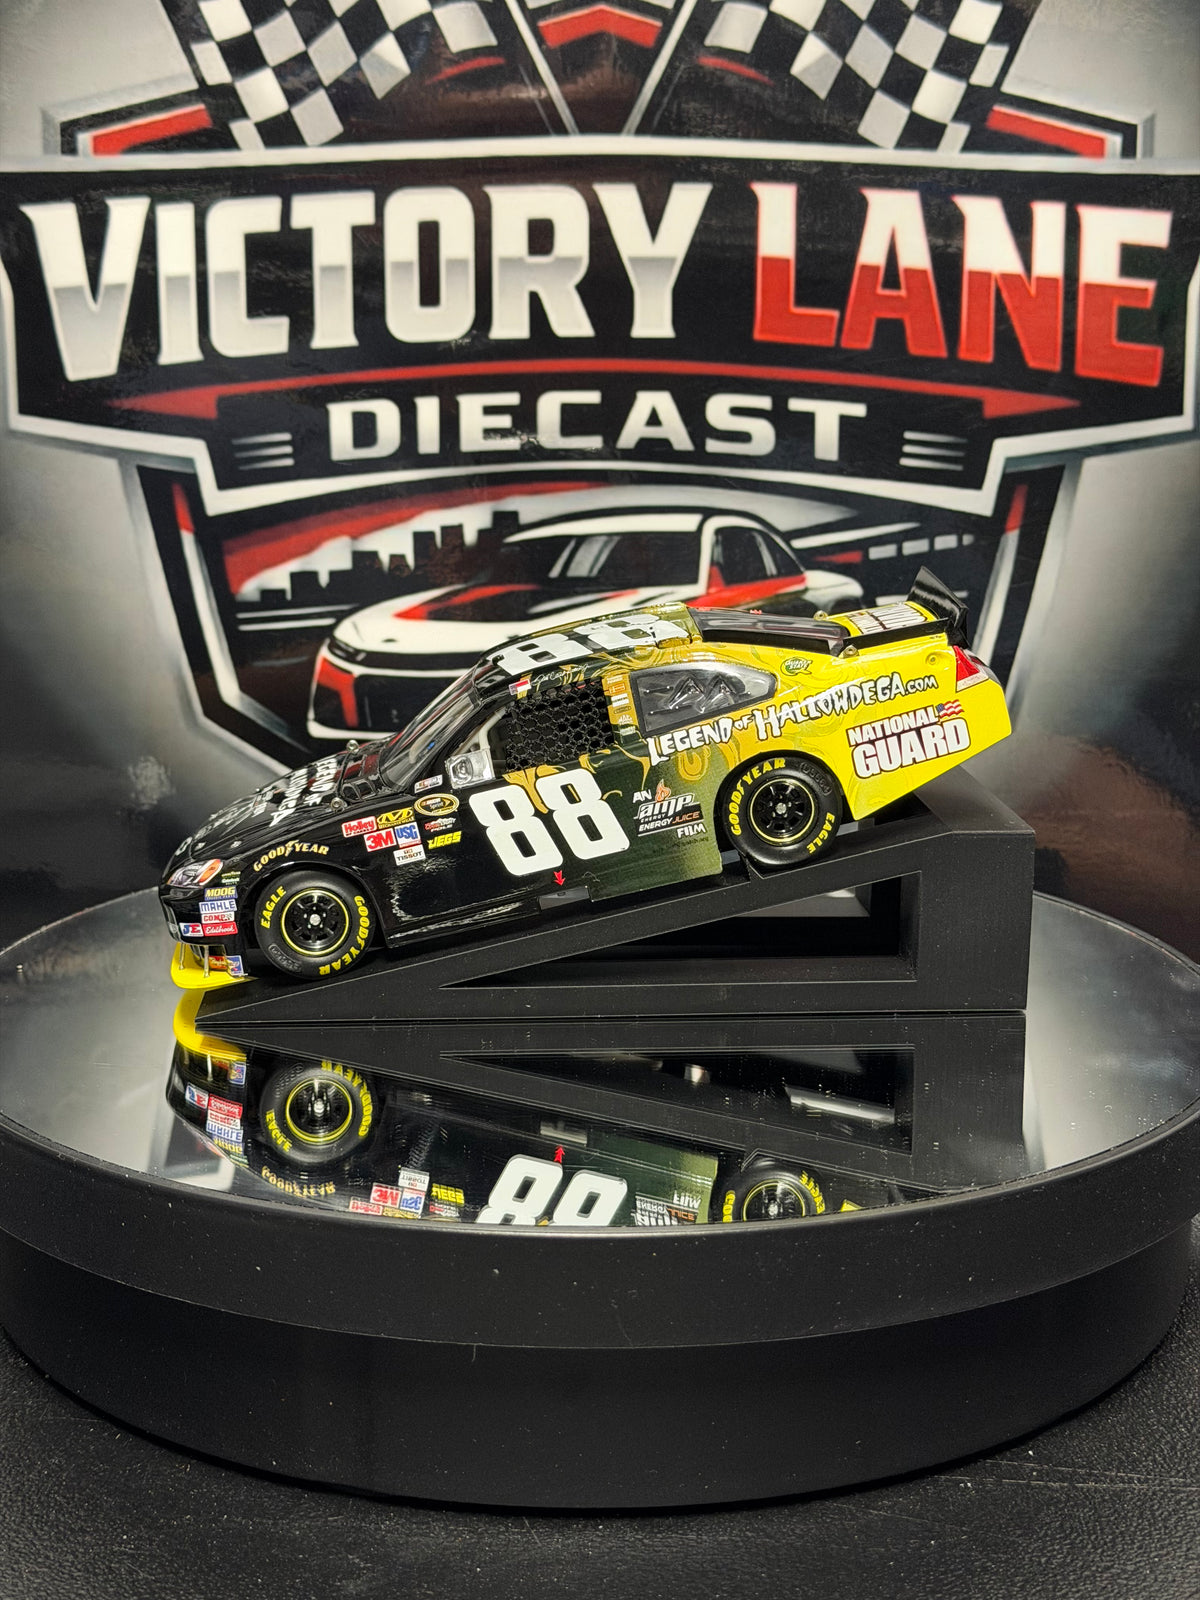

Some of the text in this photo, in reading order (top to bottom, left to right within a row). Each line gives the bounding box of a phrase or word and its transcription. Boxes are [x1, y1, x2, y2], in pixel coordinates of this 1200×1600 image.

[19, 182, 1172, 387] VICTORY LANE
[327, 390, 867, 461] DIECAST
[846, 704, 940, 748] NATIONAL
[645, 717, 735, 767] LEGEND
[734, 715, 752, 731] OF
[852, 718, 971, 779] GUARD
[633, 789, 652, 803] AN
[729, 757, 786, 836] GOODYEAR
[344, 820, 375, 834] Holley
[469, 768, 630, 876] 88
[639, 811, 700, 832] ENERGY JUICE
[640, 813, 666, 823] ENERGY
[366, 830, 394, 849] 3M
[396, 825, 419, 840] USG
[428, 831, 462, 850] JEGS
[677, 823, 706, 838] FILM
[806, 812, 835, 853] EAGLE
[253, 839, 330, 872] GOODYEAR
[397, 851, 422, 861] TISSOT
[205, 887, 236, 897] MOOG
[201, 900, 236, 912] MAHLE
[261, 885, 287, 929] EAGLE
[183, 924, 201, 935] JE
[319, 894, 371, 976] GOODYEAR
